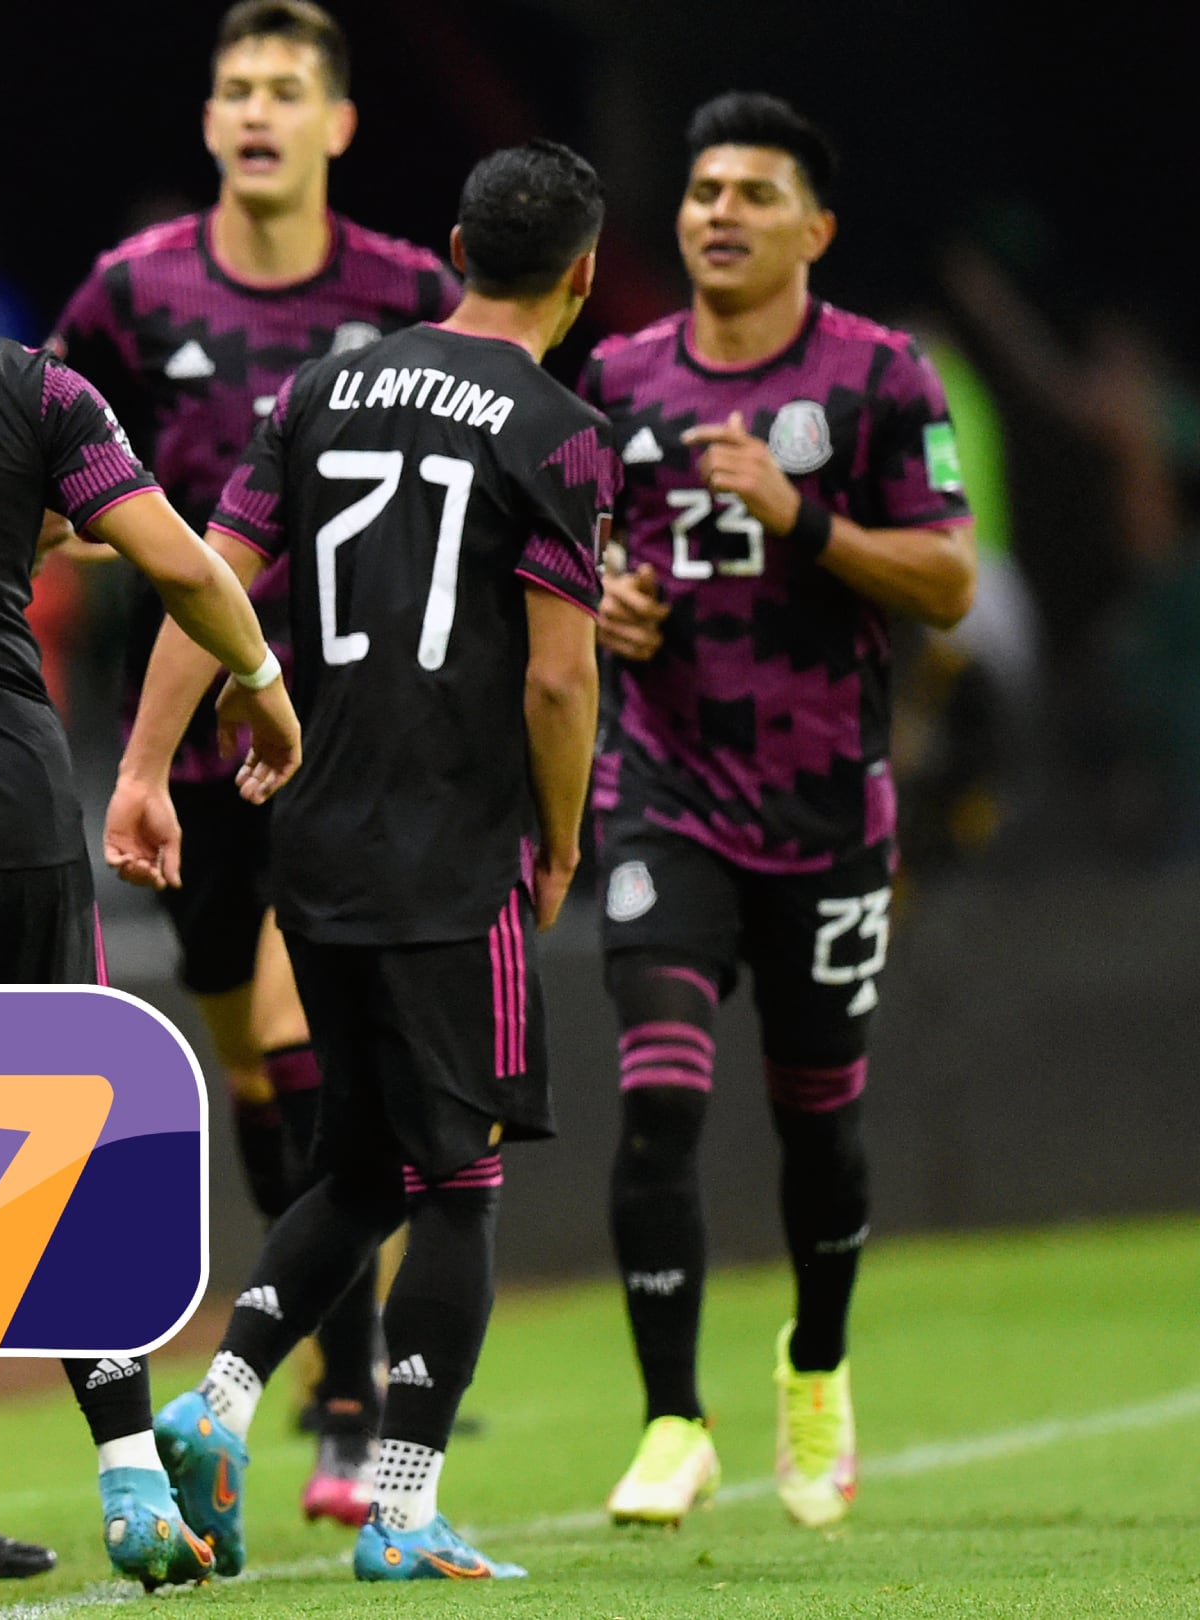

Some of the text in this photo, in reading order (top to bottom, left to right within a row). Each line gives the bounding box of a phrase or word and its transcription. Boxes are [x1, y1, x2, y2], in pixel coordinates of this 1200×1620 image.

[329, 368, 514, 435] U. ANTUNA
[316, 450, 475, 672] 27
[666, 489, 765, 579] 23
[811, 887, 892, 984] 23
[85, 1362, 142, 1390] adidas
